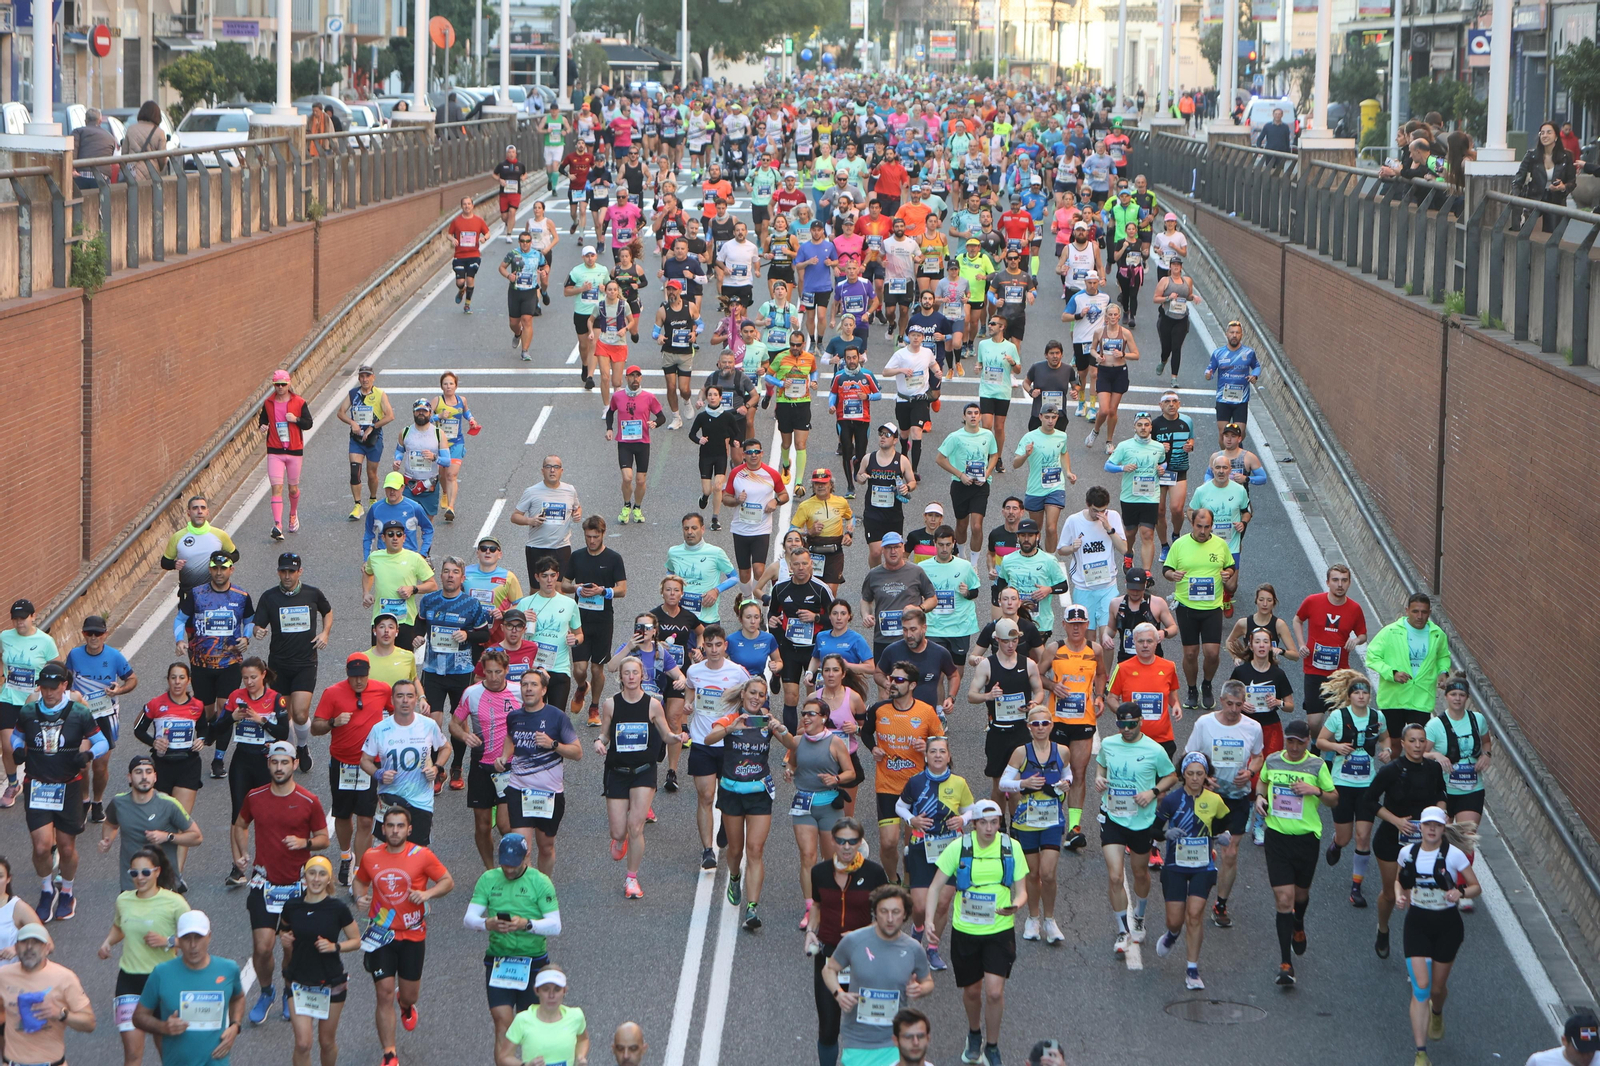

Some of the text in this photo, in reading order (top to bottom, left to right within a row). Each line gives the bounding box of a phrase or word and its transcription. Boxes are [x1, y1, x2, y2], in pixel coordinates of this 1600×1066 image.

[1156, 433, 1172, 442] SLY
[387, 746, 420, 771] 10
[735, 763, 763, 775] Sigfrido
[403, 910, 421, 920] RUN
